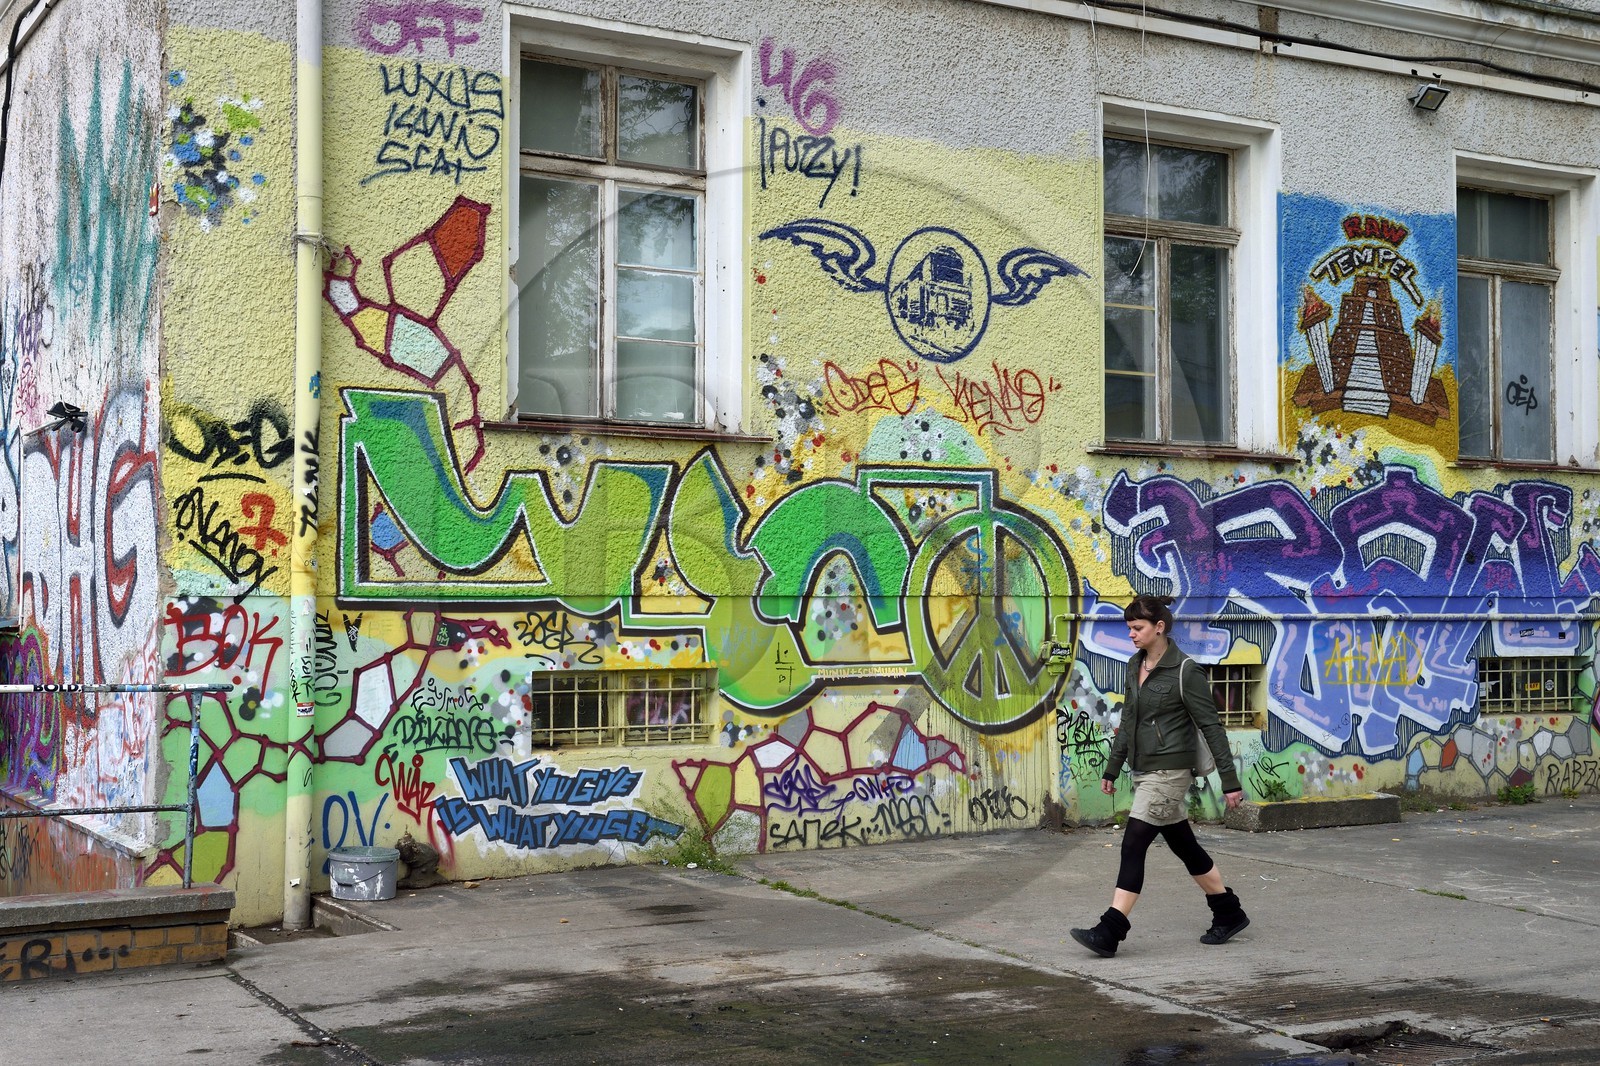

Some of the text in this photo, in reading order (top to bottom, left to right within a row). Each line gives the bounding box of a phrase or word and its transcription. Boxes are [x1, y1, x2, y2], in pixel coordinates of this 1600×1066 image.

[1342, 214, 1410, 248] RAW
[1310, 245, 1424, 307] TEMPEL
[448, 756, 541, 809] WHAT
[531, 767, 573, 806] YOU
[474, 804, 551, 850] WHAT
[549, 810, 607, 848] YOU
